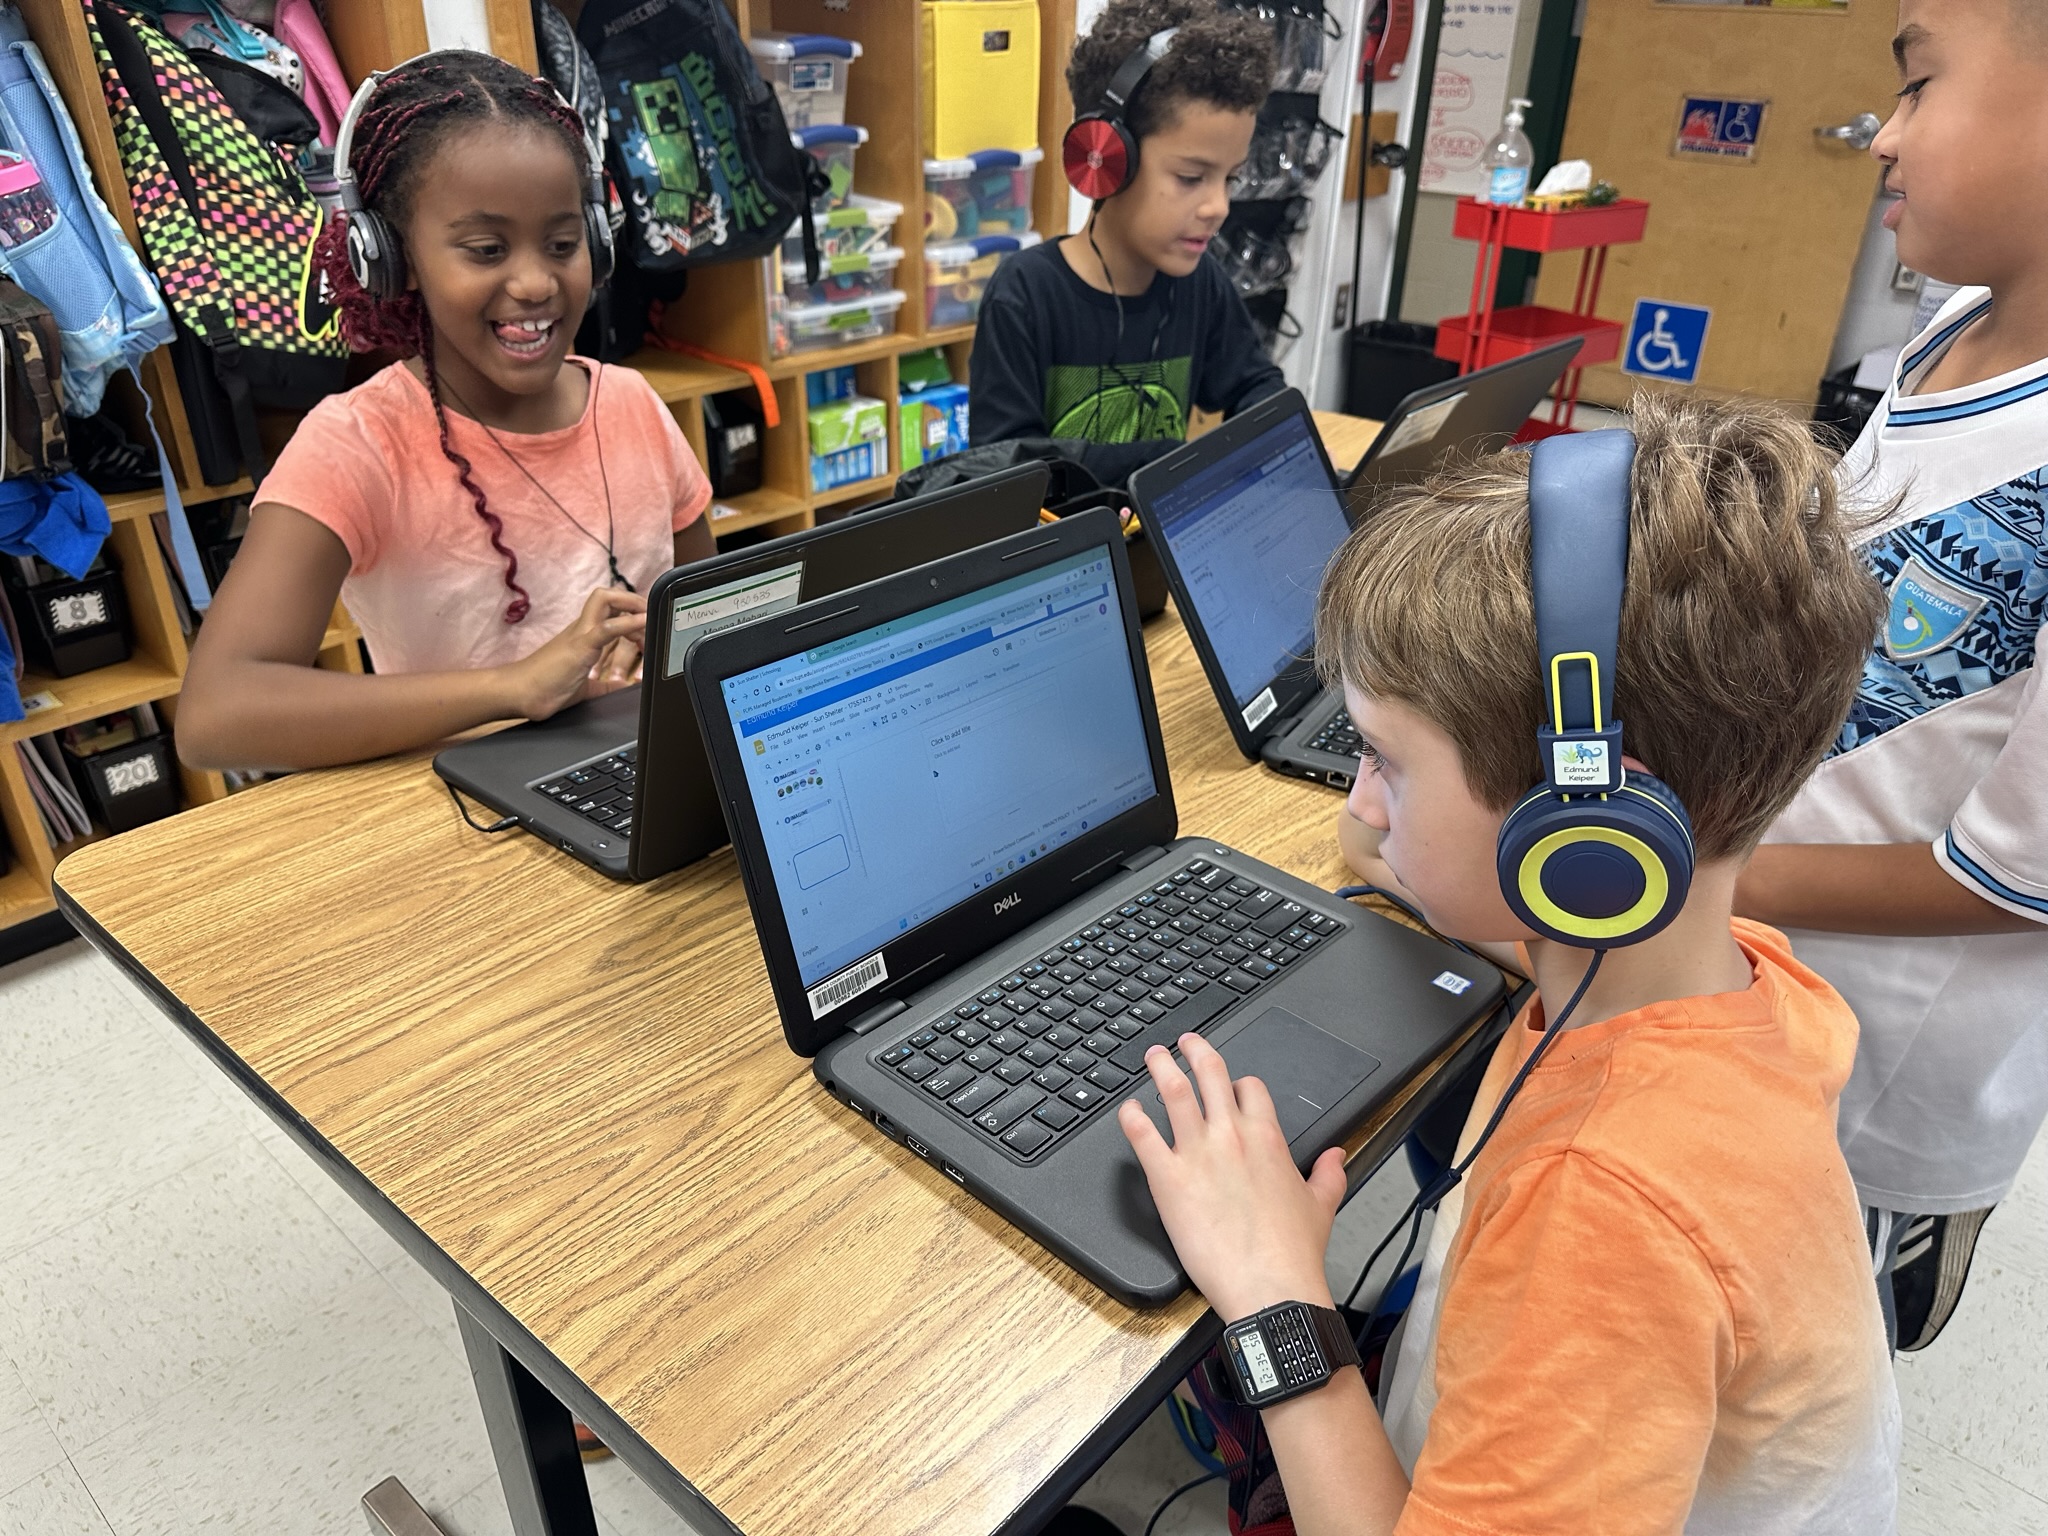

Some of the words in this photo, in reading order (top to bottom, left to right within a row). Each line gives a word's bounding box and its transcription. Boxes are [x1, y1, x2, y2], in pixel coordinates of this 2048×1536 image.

[1905, 581, 1963, 618] GUATEMALA
[70, 600, 87, 620] 8
[746, 708, 776, 725] Edmund
[776, 699, 799, 715] Keiper
[766, 726, 791, 742] Edmund
[790, 719, 810, 733] Keiper
[813, 713, 825, 723] Sun
[824, 705, 844, 718] Shelter
[769, 743, 779, 751] File
[782, 737, 793, 746] Edit
[796, 731, 808, 740] View
[812, 724, 825, 734] Insert
[829, 716, 845, 727] Format
[848, 710, 860, 719] Slide
[863, 702, 881, 714] Arrange
[884, 696, 895, 705] Tools
[930, 736, 945, 748] Click
[951, 729, 961, 739] add
[961, 724, 971, 734] title
[115, 761, 150, 788] 20
[970, 857, 986, 868] Support
[993, 892, 1022, 915] DELL
[802, 945, 819, 957] English
[1118, 985, 1128, 993] H
[1155, 991, 1165, 999] N
[994, 1035, 1006, 1044] W
[885, 1051, 897, 1060] Esc
[1024, 1049, 1033, 1057] S
[1062, 1056, 1073, 1064] X
[928, 1078, 939, 1087] Tab
[1037, 1074, 1047, 1082] Z
[953, 1092, 967, 1104] Caps
[965, 1085, 979, 1097] Lock
[979, 1111, 994, 1122] Shift
[1038, 1108, 1047, 1116] Fn
[1006, 1130, 1018, 1140] Ctrl
[1241, 1338, 1250, 1348] FR
[1248, 1333, 1261, 1348] 58
[1256, 1353, 1274, 1383] 12:35
[1245, 1378, 1255, 1395] CASIO
